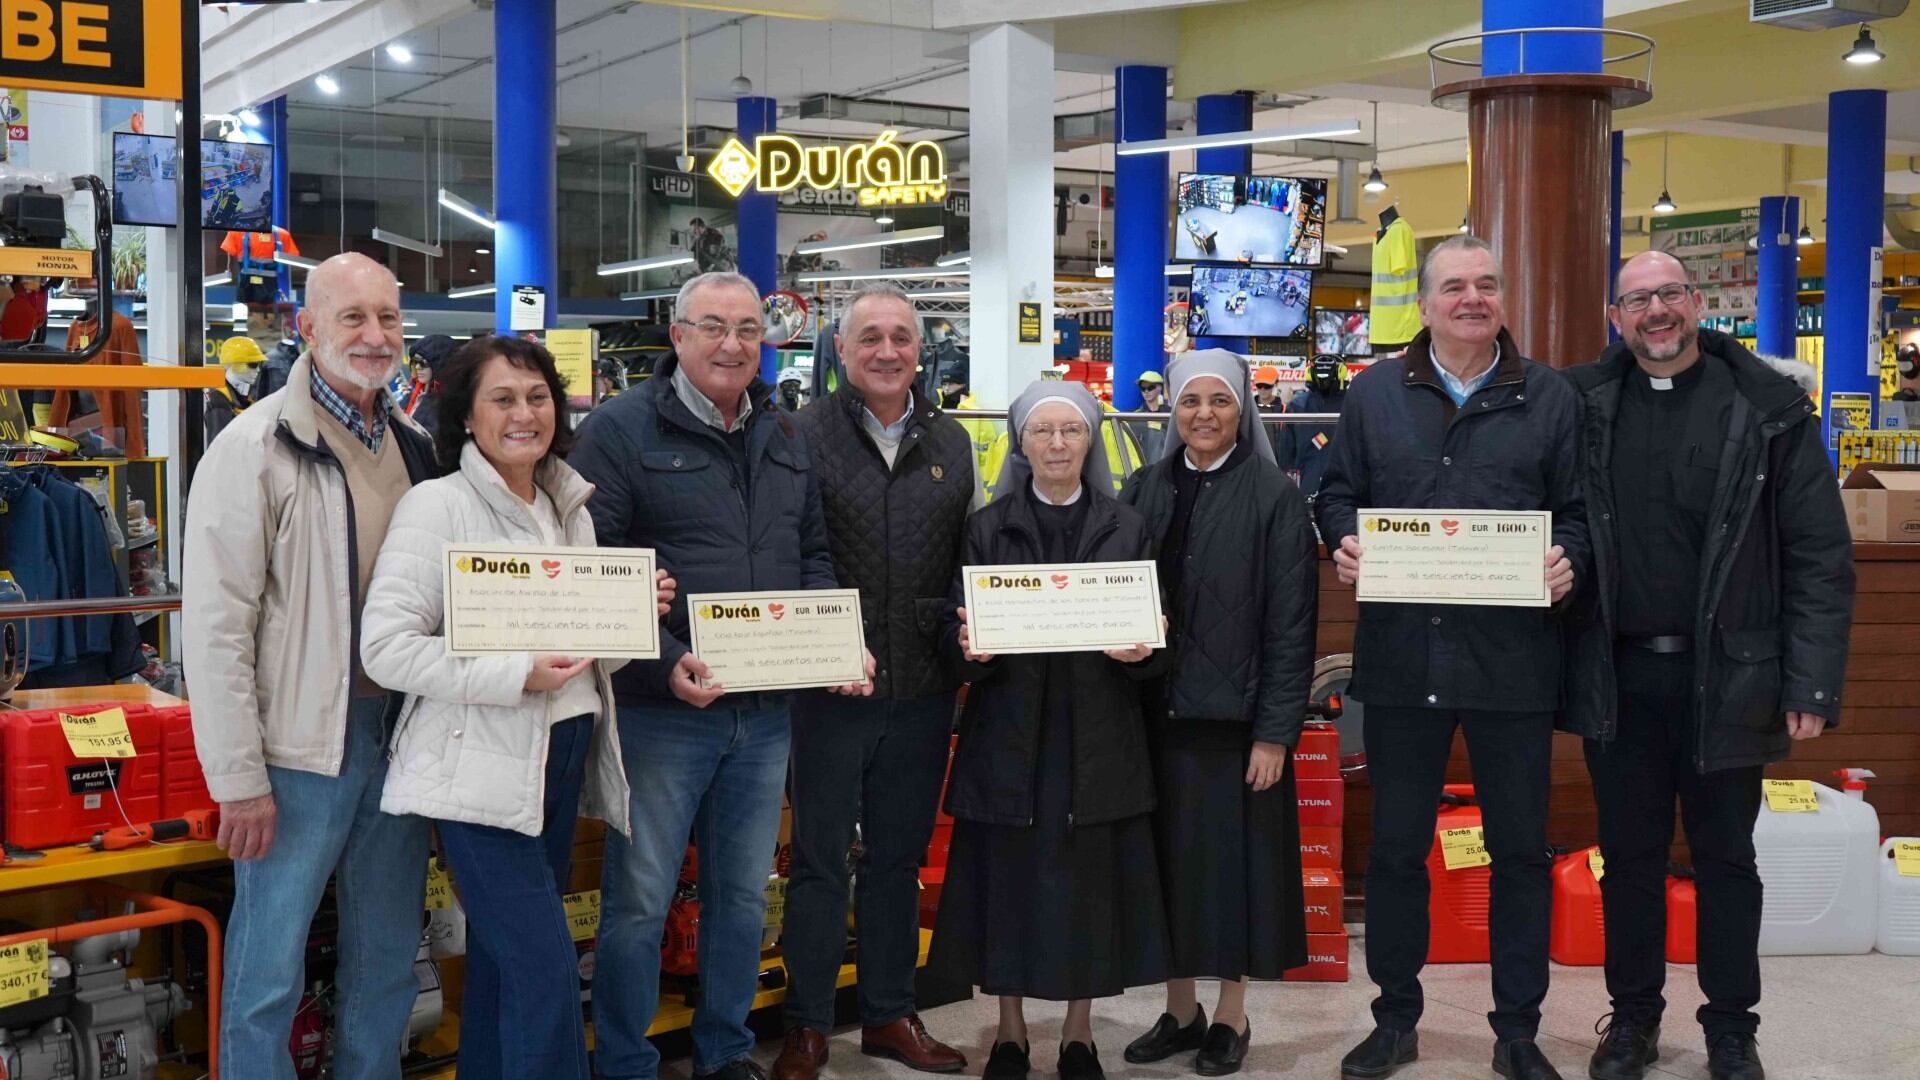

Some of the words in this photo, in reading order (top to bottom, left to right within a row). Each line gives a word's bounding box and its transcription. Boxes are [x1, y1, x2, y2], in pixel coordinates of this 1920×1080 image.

[1, 0, 111, 68] BE
[755, 130, 945, 192] Durán
[858, 183, 947, 207] SAFETY
[41, 255, 74, 263] MOTOR
[36, 261, 78, 271] HONDA
[1377, 517, 1431, 533] Durán
[1471, 524, 1489, 532] EUR
[1497, 522, 1527, 533] 1600
[471, 557, 531, 574] Durán
[574, 566, 592, 575] EUR
[601, 565, 632, 577] 1600
[989, 575, 1042, 588] Durán
[1105, 575, 1134, 585] 1600
[712, 603, 760, 619] Durán
[795, 607, 810, 615] EUR
[816, 604, 842, 615] 1600
[66, 714, 97, 724] Durán
[88, 736, 122, 747] 151,95
[124, 734, 132, 744] €
[1293, 753, 1328, 761] LTUNA
[1297, 799, 1332, 807] LTUNA
[1447, 829, 1471, 837] Durán
[41, 969, 48, 980] €
